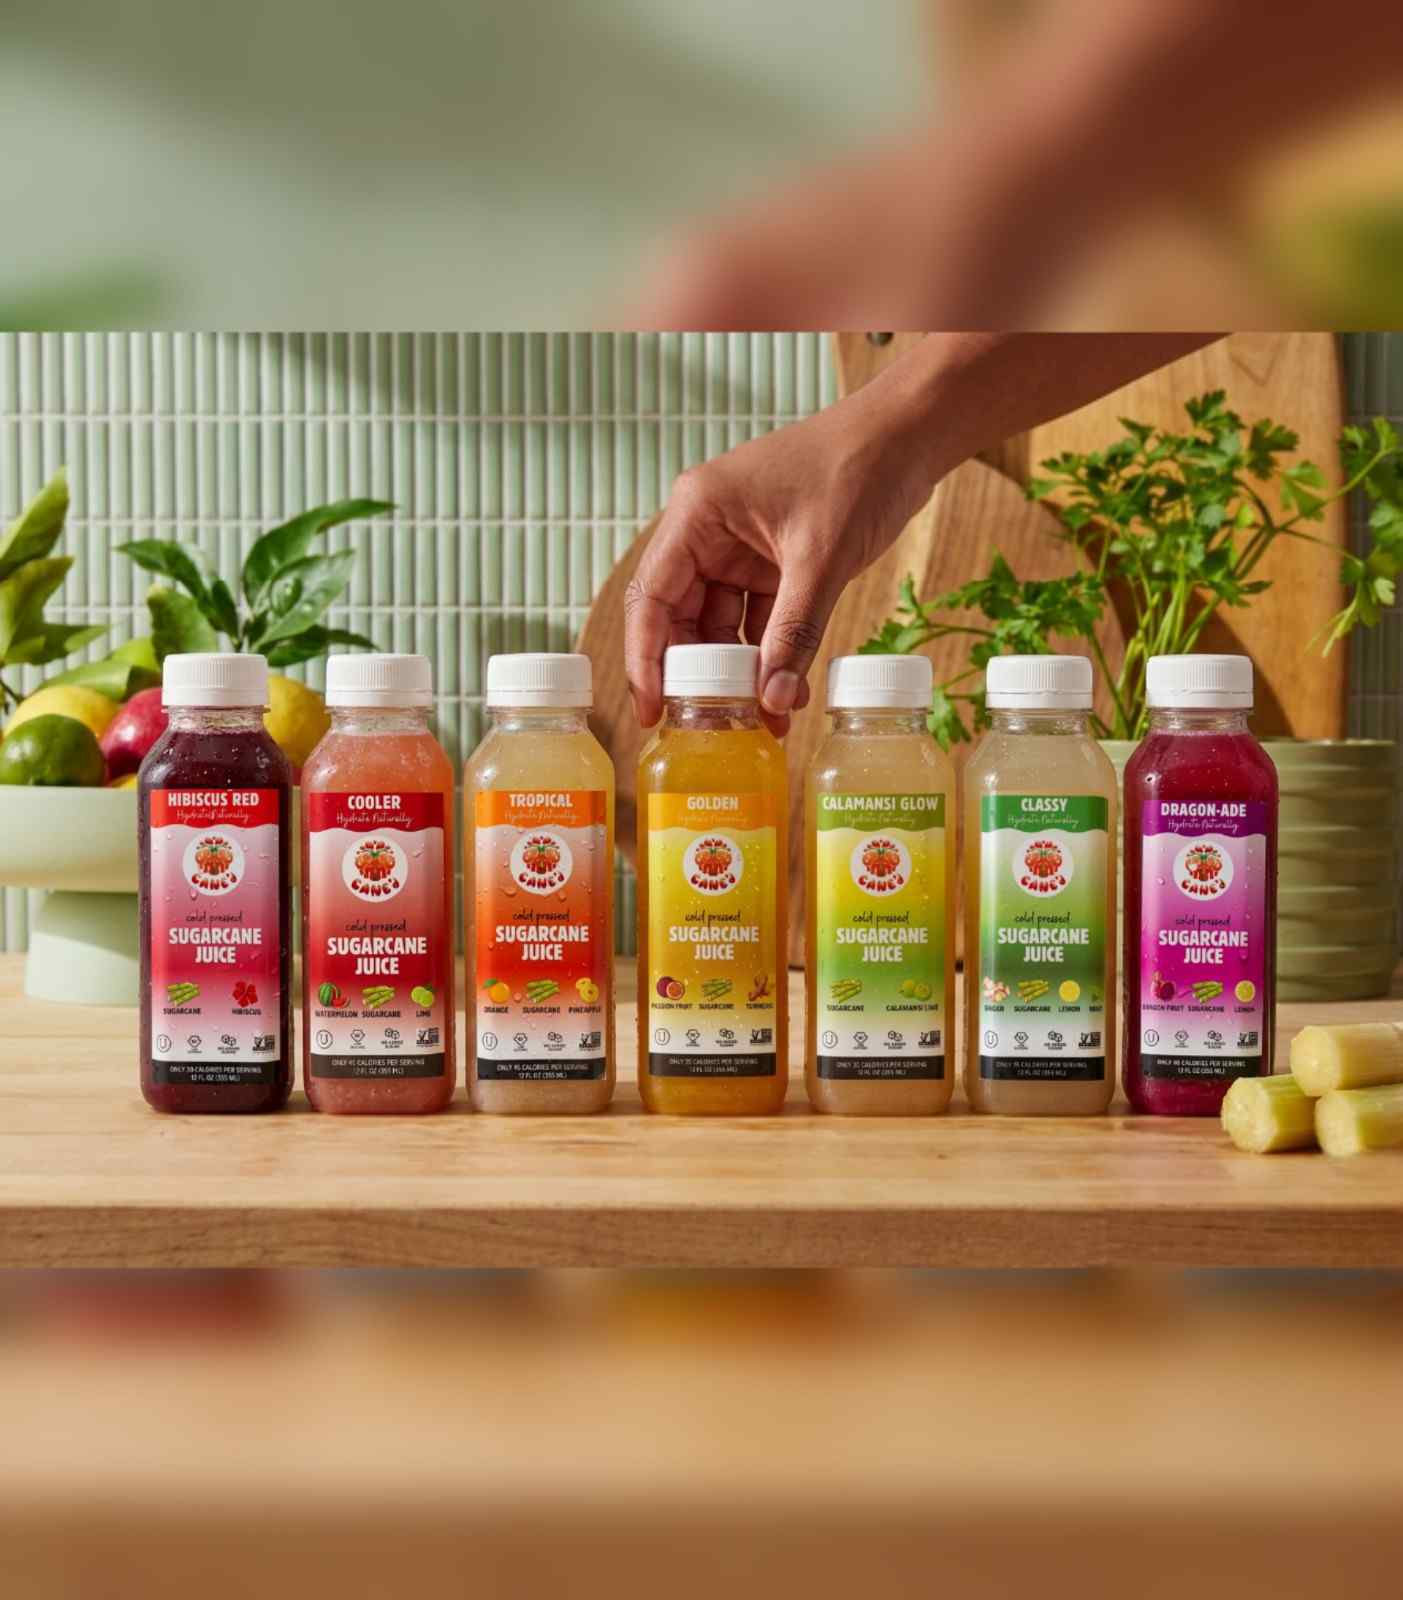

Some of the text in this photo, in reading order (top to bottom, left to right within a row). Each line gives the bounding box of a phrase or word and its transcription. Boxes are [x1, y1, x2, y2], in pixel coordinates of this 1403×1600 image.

[168, 792, 260, 806] HIBISCUS RED
[348, 795, 401, 810] COOLER
[510, 794, 573, 808] TROPICAL
[687, 796, 738, 810] GOLDEN
[823, 796, 938, 810] CALAMANSI GLOW
[1021, 798, 1068, 812] CLASSY
[1160, 803, 1246, 817] DRAGON-ADE
[336, 810, 414, 828] Hydrate Naturally
[1168, 818, 1240, 834] Hydrate Naturally
[186, 911, 242, 928] cold pressed
[513, 909, 570, 926] cold pressed
[685, 911, 741, 927] cold pressed
[853, 911, 910, 928] cold pressed
[1014, 911, 1071, 928] cold pressed
[1175, 915, 1231, 930] cold pressed
[169, 928, 262, 944] SUGARCANE
[345, 920, 406, 936] cold pressed
[496, 926, 590, 942] SUGARCANE
[669, 926, 760, 942] SUGARCANE
[836, 928, 928, 944] SUGARCANE
[998, 928, 1089, 944] SUGARCANE
[328, 937, 427, 955] SUGARCANE
[1158, 930, 1248, 947] SUGARCANE
[195, 946, 237, 963] JUICE
[521, 944, 563, 960] JUICE
[694, 944, 735, 960] JUICE
[862, 946, 903, 962] JUICE
[1024, 946, 1064, 962] JUICE
[1184, 948, 1224, 964] JUICE
[355, 957, 400, 975] JUICE
[362, 1010, 400, 1018] SUGARCANE
[416, 1010, 431, 1018] LIME
